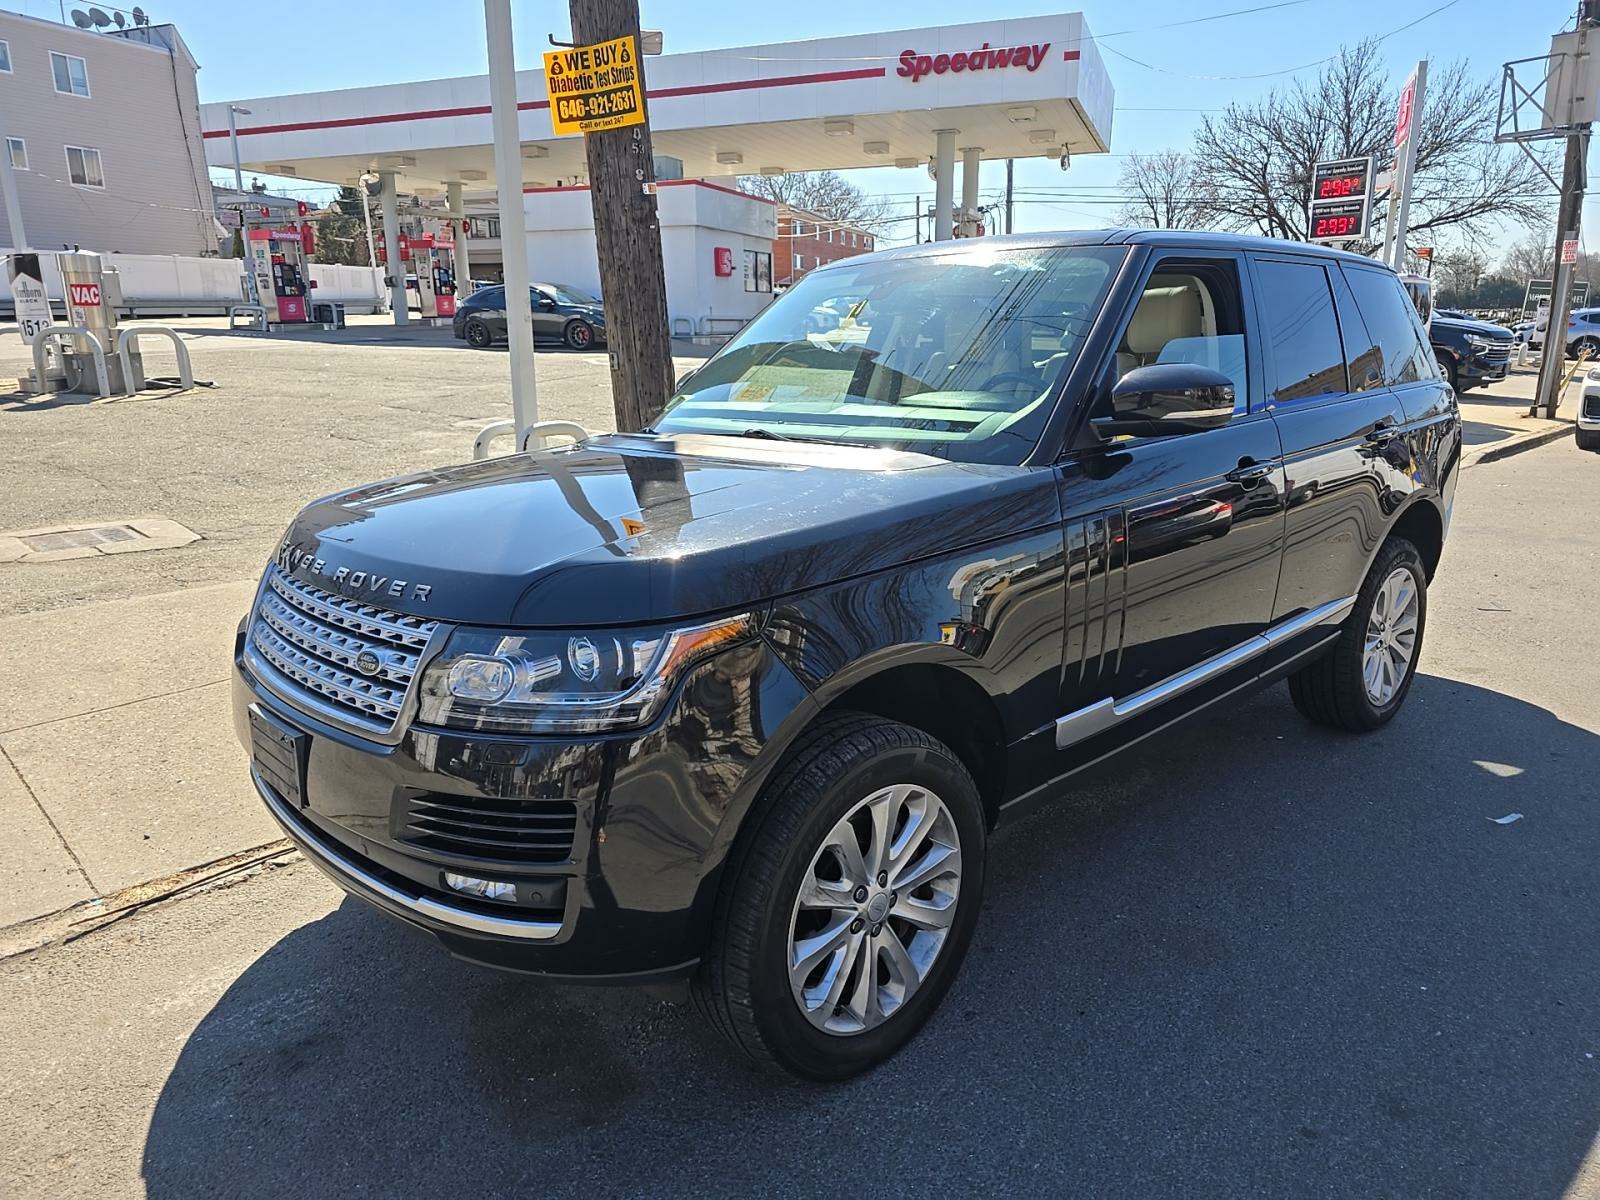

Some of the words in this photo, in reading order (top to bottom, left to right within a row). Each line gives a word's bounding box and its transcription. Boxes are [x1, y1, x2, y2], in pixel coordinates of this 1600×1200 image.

[564, 51, 591, 72] WE
[593, 44, 617, 68] BUY
[897, 43, 1051, 82] Speedway
[549, 73, 594, 93] Diabetic
[594, 70, 611, 88] Test
[611, 64, 634, 84] Strips
[560, 89, 635, 119] 646-921-2631
[579, 121, 593, 129] Call
[602, 118, 613, 127] text
[614, 116, 624, 125] 24/7
[1321, 178, 1351, 197] 2.92
[272, 231, 300, 240] Speedway
[71, 286, 99, 304] VAC
[333, 566, 432, 602] ROVER
